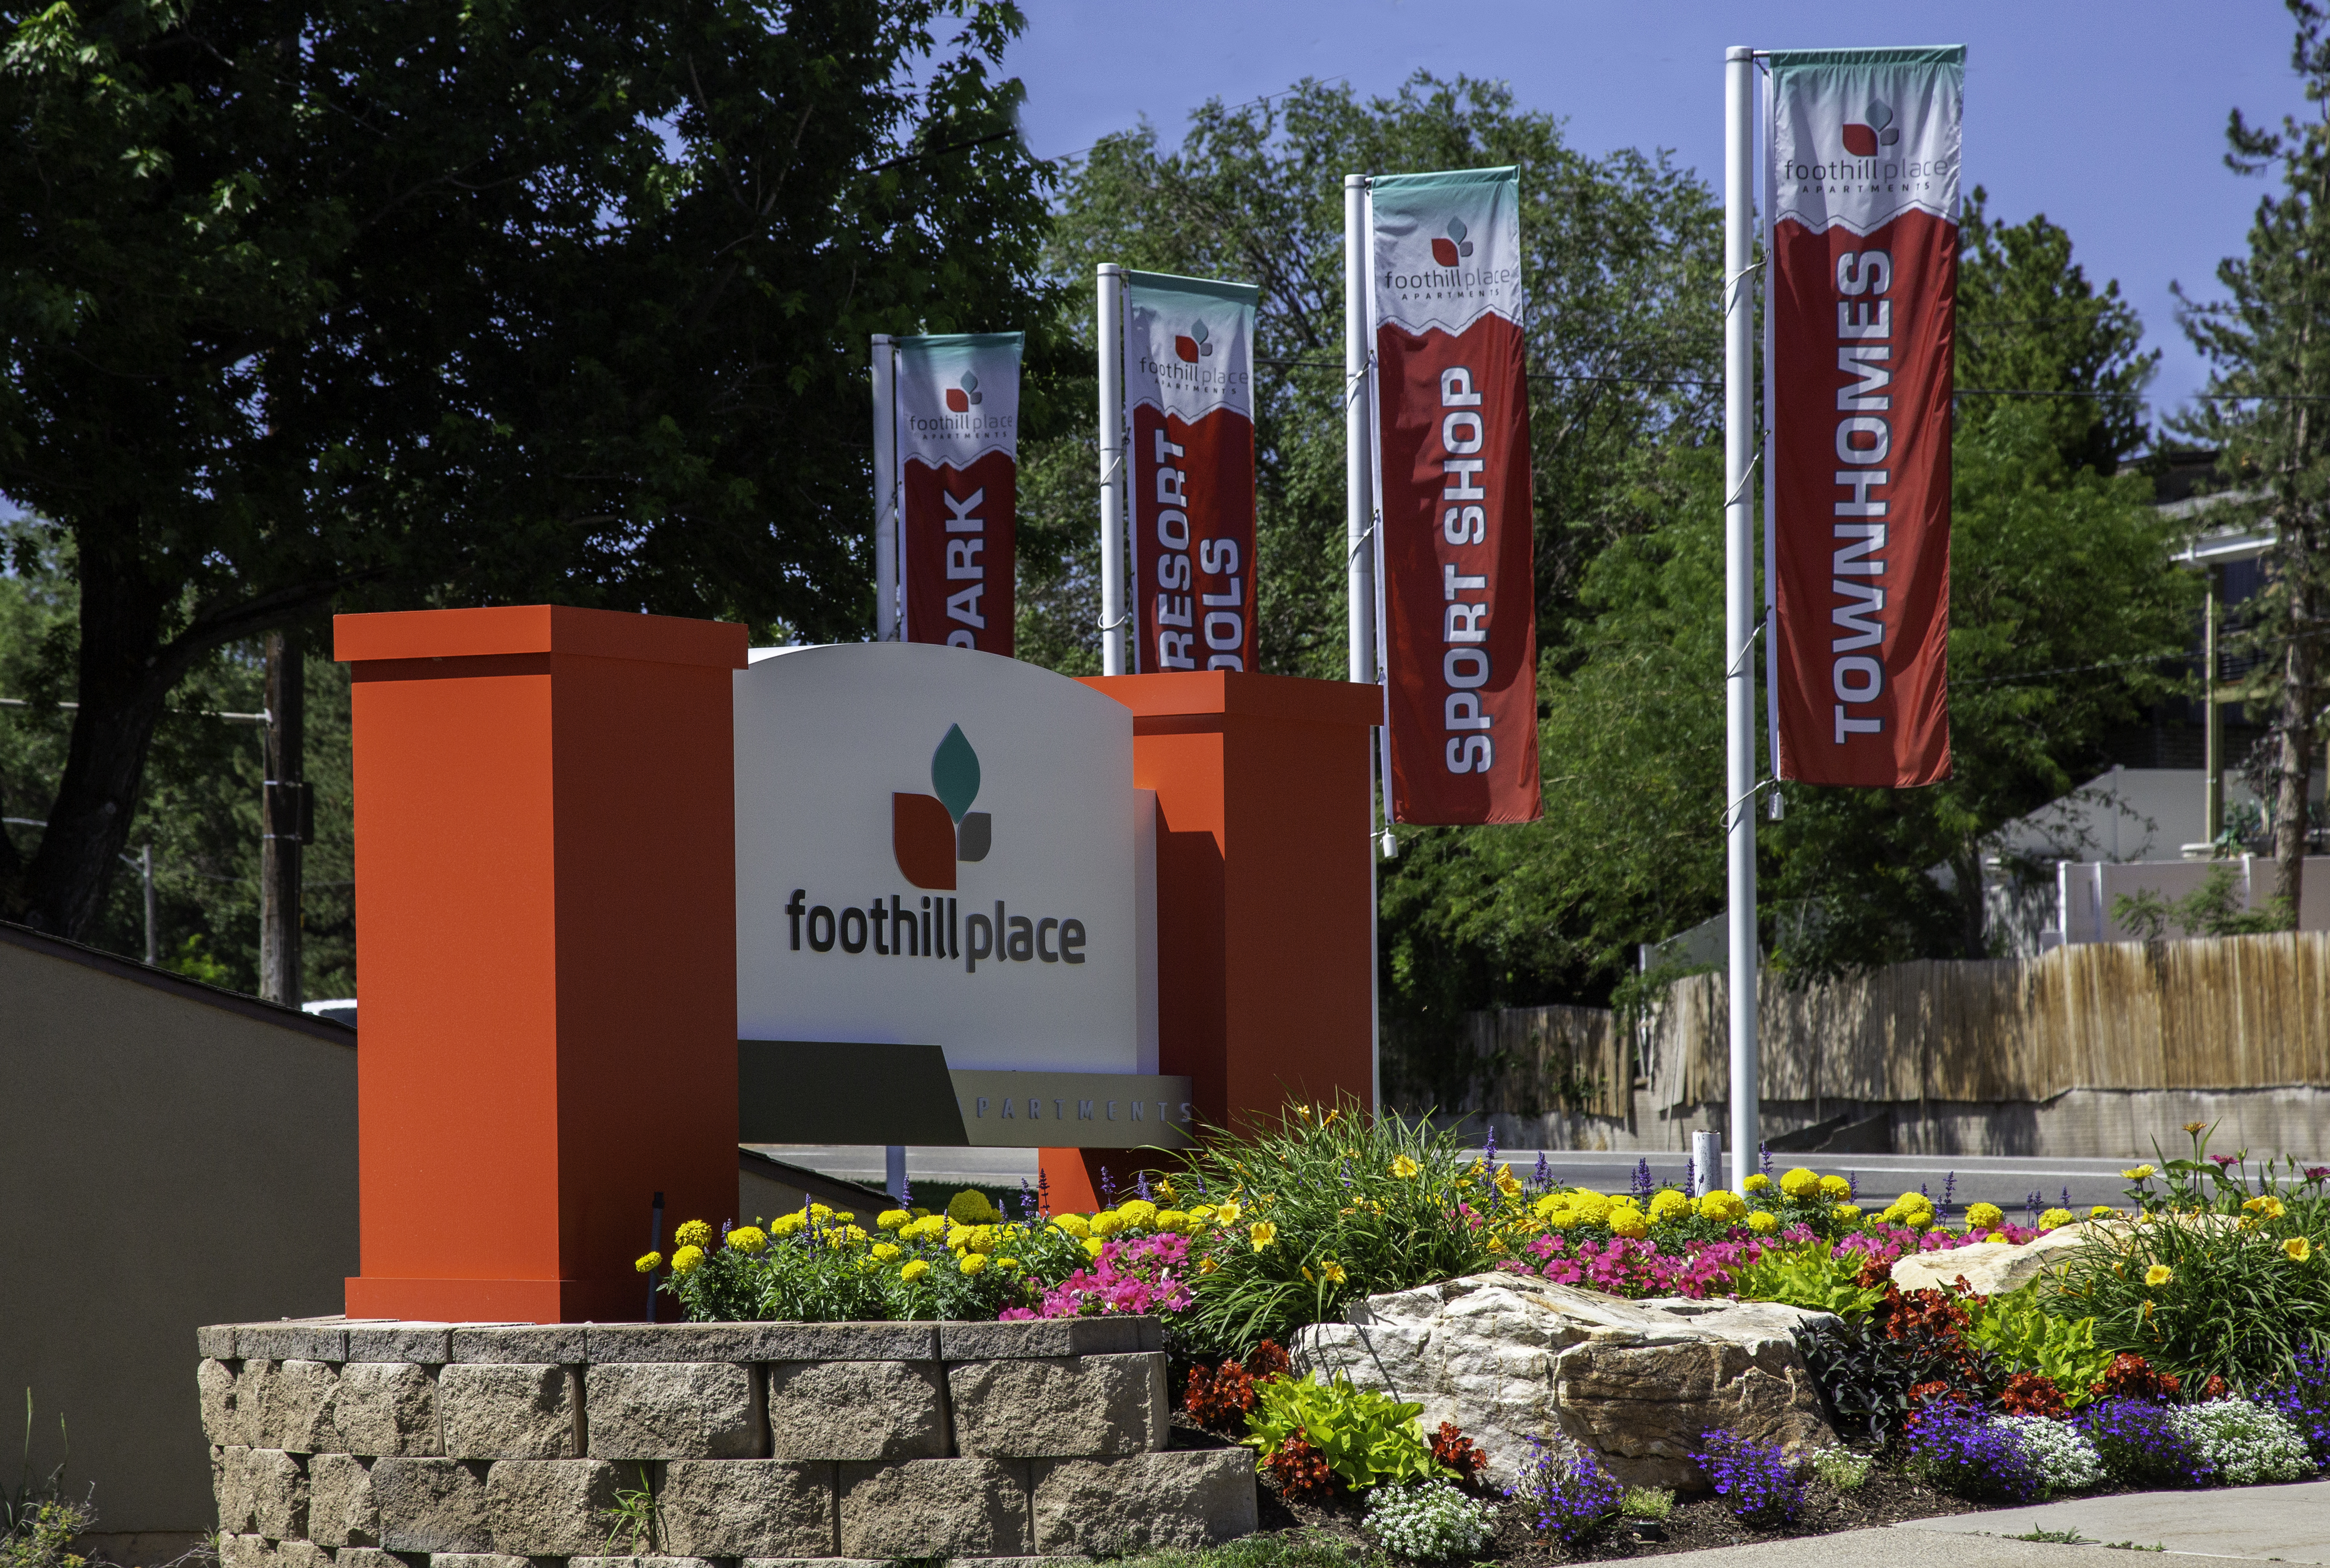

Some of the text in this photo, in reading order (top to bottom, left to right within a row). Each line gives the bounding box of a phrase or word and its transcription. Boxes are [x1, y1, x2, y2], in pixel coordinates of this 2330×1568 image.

[1784, 158, 1948, 183] foothill place
[1802, 182, 1930, 193] APARTMENTS
[1385, 268, 1510, 290] foothill place
[1402, 288, 1499, 300] APARTMENTS
[1139, 357, 1248, 385] foothill place
[1155, 377, 1236, 395] APARTMENTS
[910, 414, 1013, 432] foothill place
[923, 431, 1007, 440] APARTMENTS
[1832, 250, 1890, 744] TOWNHOMES
[1155, 429, 1195, 670] RESORT
[1441, 367, 1492, 774] SPORT SHOP
[785, 889, 1086, 973] foothill place
